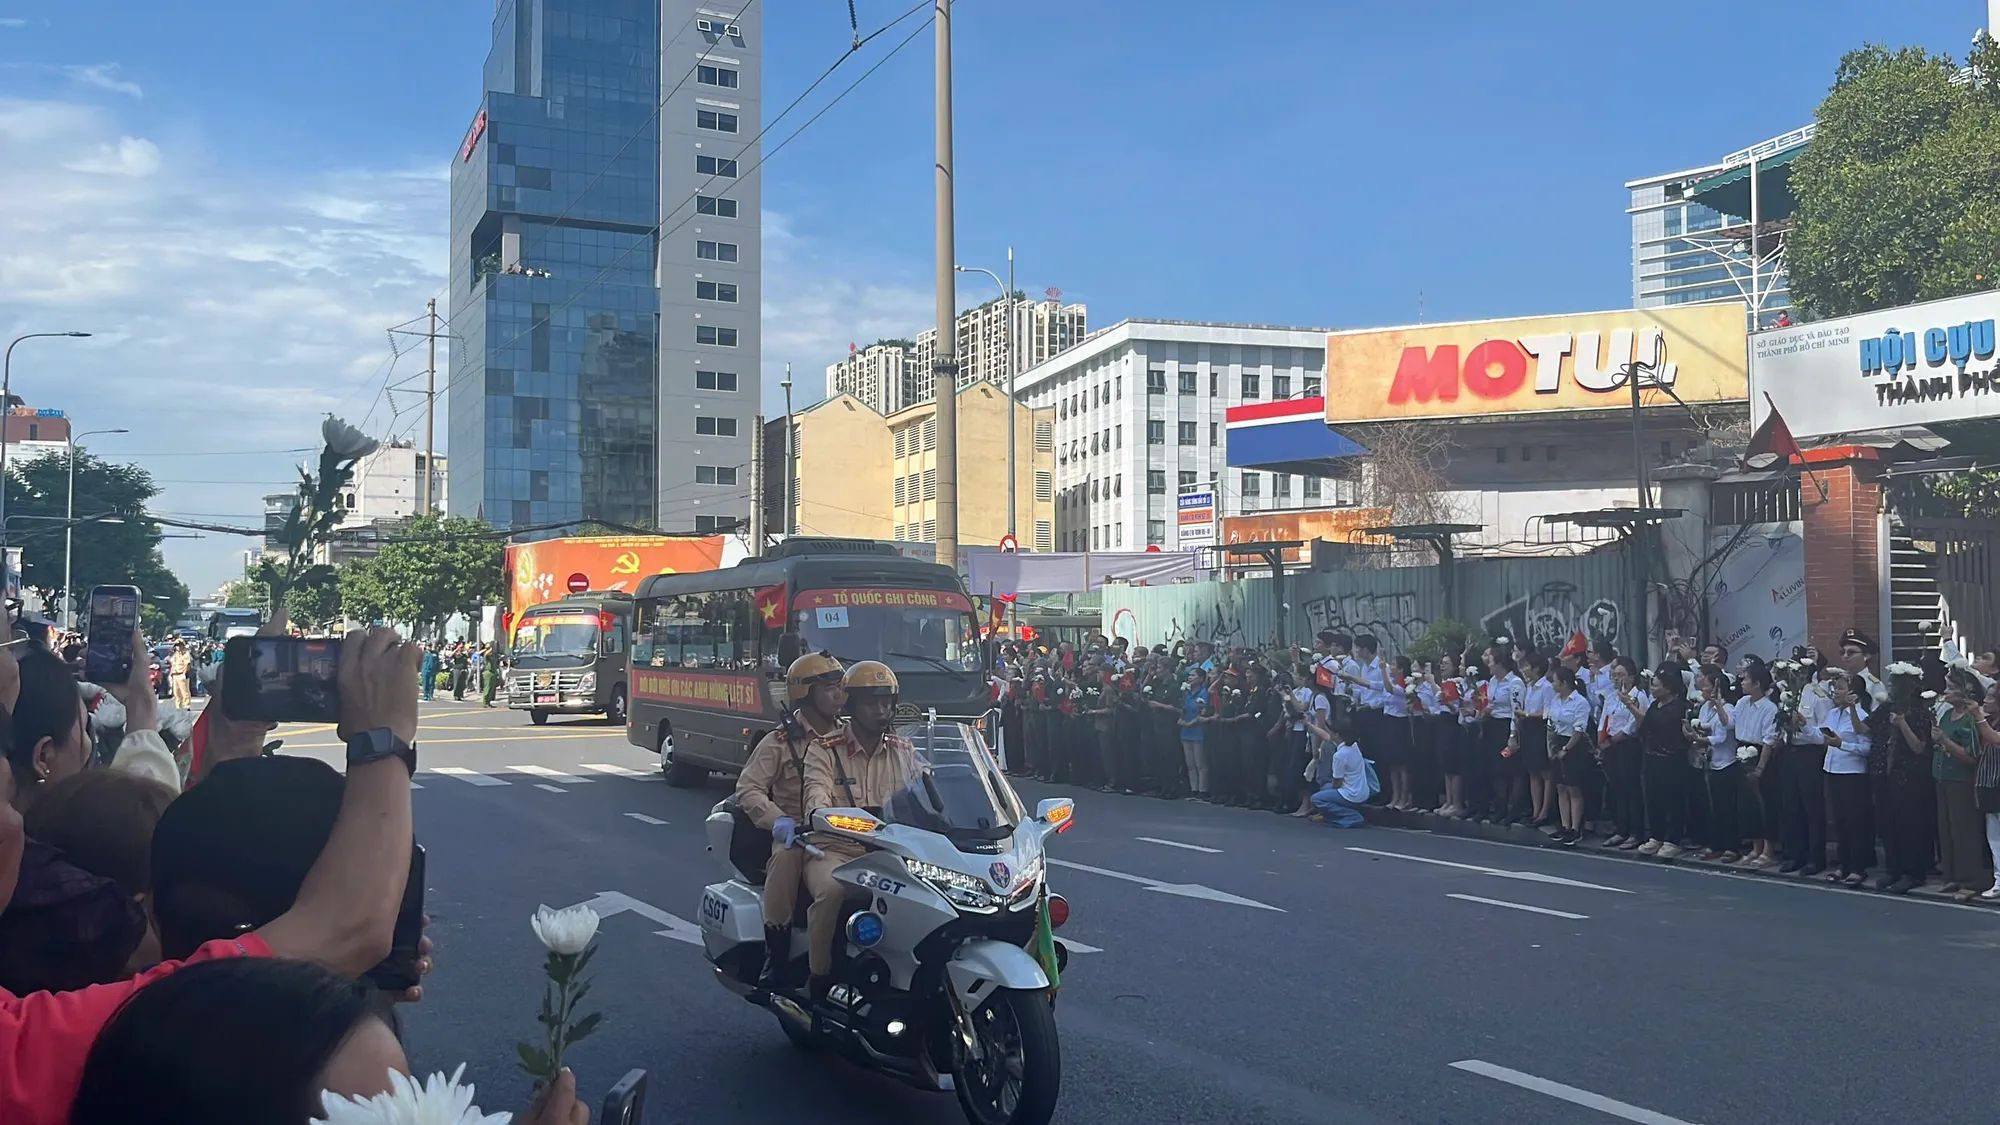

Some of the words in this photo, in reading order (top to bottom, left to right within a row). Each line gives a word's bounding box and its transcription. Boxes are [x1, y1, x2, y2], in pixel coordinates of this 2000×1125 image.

[1757, 340, 1766, 349] SỞ
[1769, 337, 1787, 347] GIÁO
[1790, 334, 1804, 344] DỤC
[1807, 331, 1816, 340] VÀ
[1818, 329, 1832, 339] ĐÀO
[1835, 327, 1850, 337] TẠO
[1757, 348, 1782, 359] THÀNH
[1783, 341, 1798, 355] PHỐ
[1800, 342, 1810, 352] HỒ
[1812, 340, 1825, 350] CHÍ
[1828, 337, 1850, 347] MINH
[1859, 327, 1916, 378] HỘI
[1924, 319, 1995, 369] CỰU
[1387, 328, 1678, 404] MOTUL
[1875, 375, 1953, 407] THÀNH
[833, 589, 848, 605] TỔ
[851, 590, 882, 606] QUỐC
[885, 593, 903, 605] GHI
[907, 592, 937, 606] CÔNG
[825, 612, 840, 623] 04
